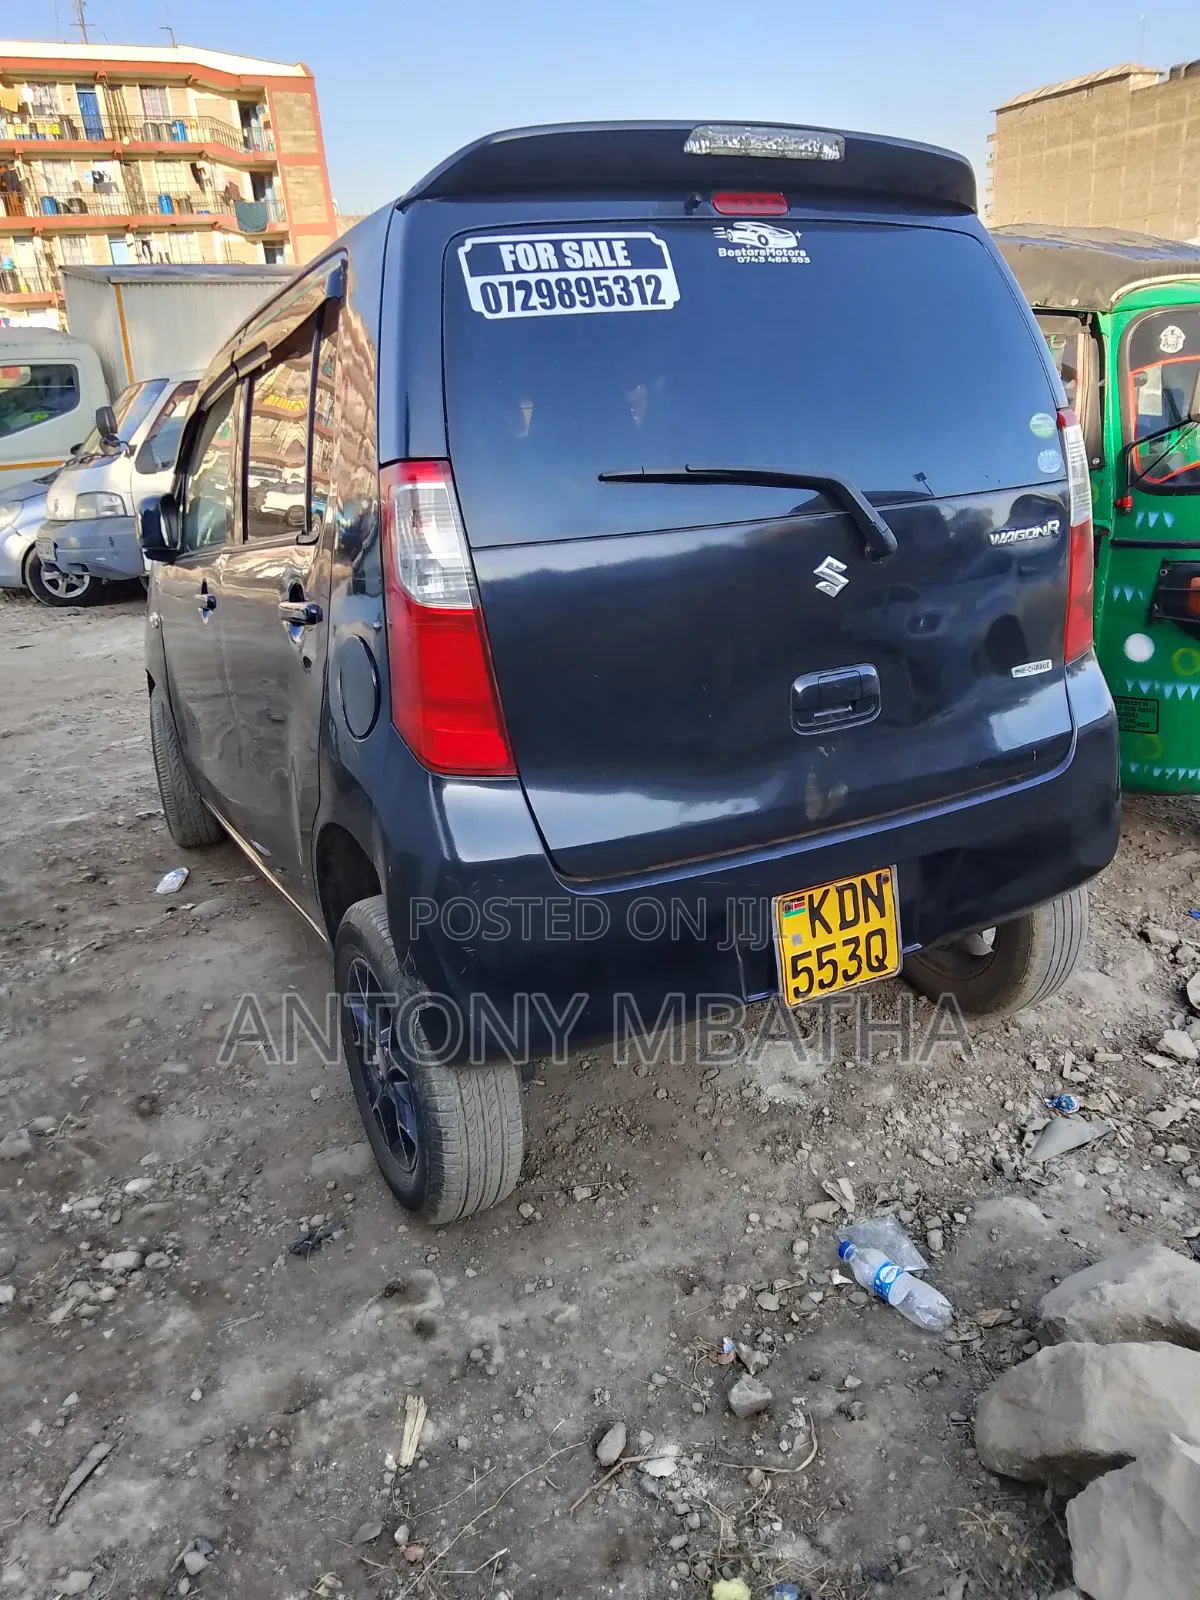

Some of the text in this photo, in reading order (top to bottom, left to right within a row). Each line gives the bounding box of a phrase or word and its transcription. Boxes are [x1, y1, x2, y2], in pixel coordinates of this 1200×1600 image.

[498, 240, 632, 272] FOR SALE
[479, 274, 666, 314] 0729895312
[807, 872, 886, 939] KDN
[790, 927, 889, 1000] 553Q
